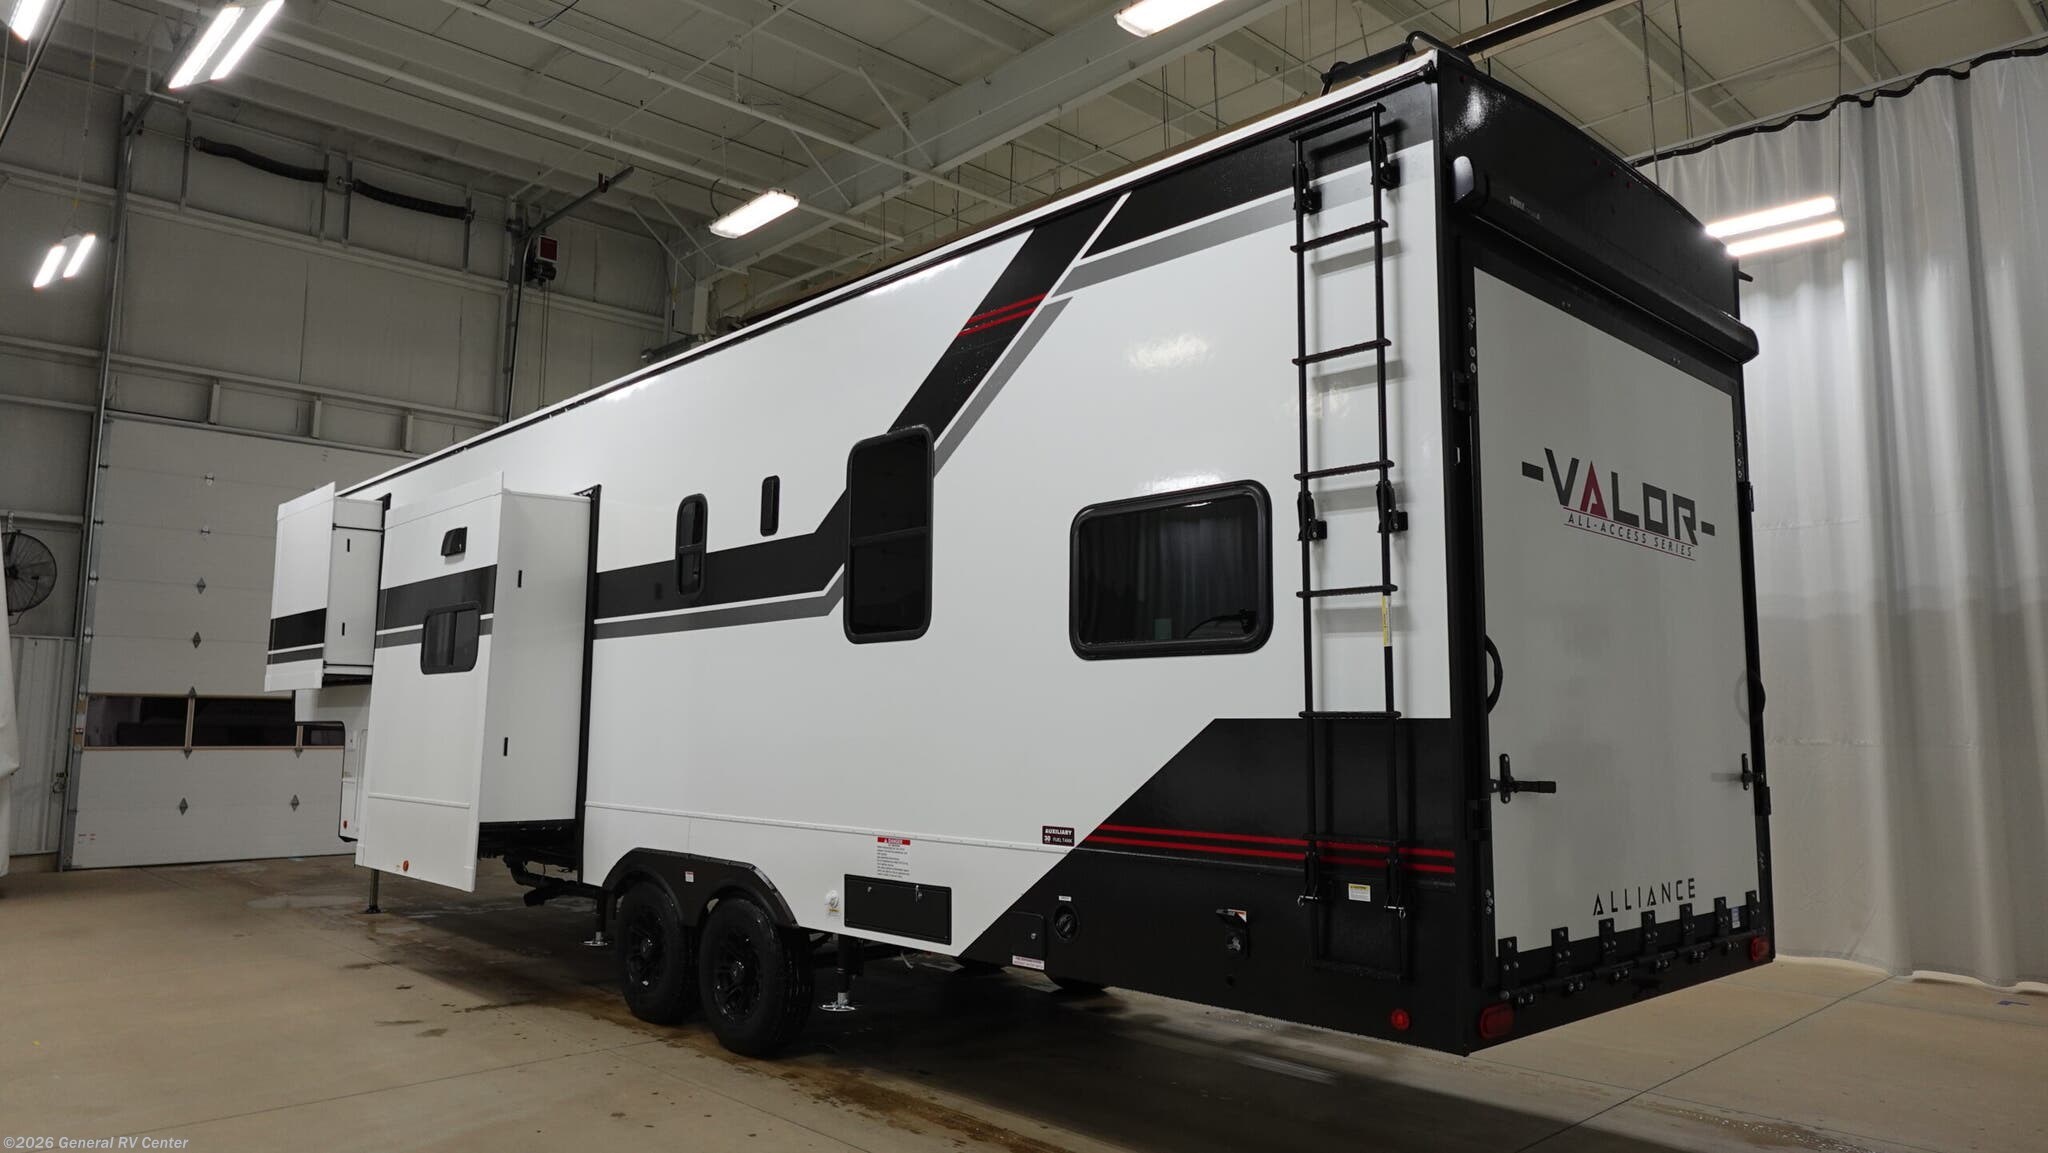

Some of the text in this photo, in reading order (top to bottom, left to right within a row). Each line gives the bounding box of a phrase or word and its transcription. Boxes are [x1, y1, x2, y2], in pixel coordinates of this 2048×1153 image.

[1568, 513, 1693, 557] ALL-ACCESS SERIES
[1593, 877, 1697, 916] ALLIANCE
